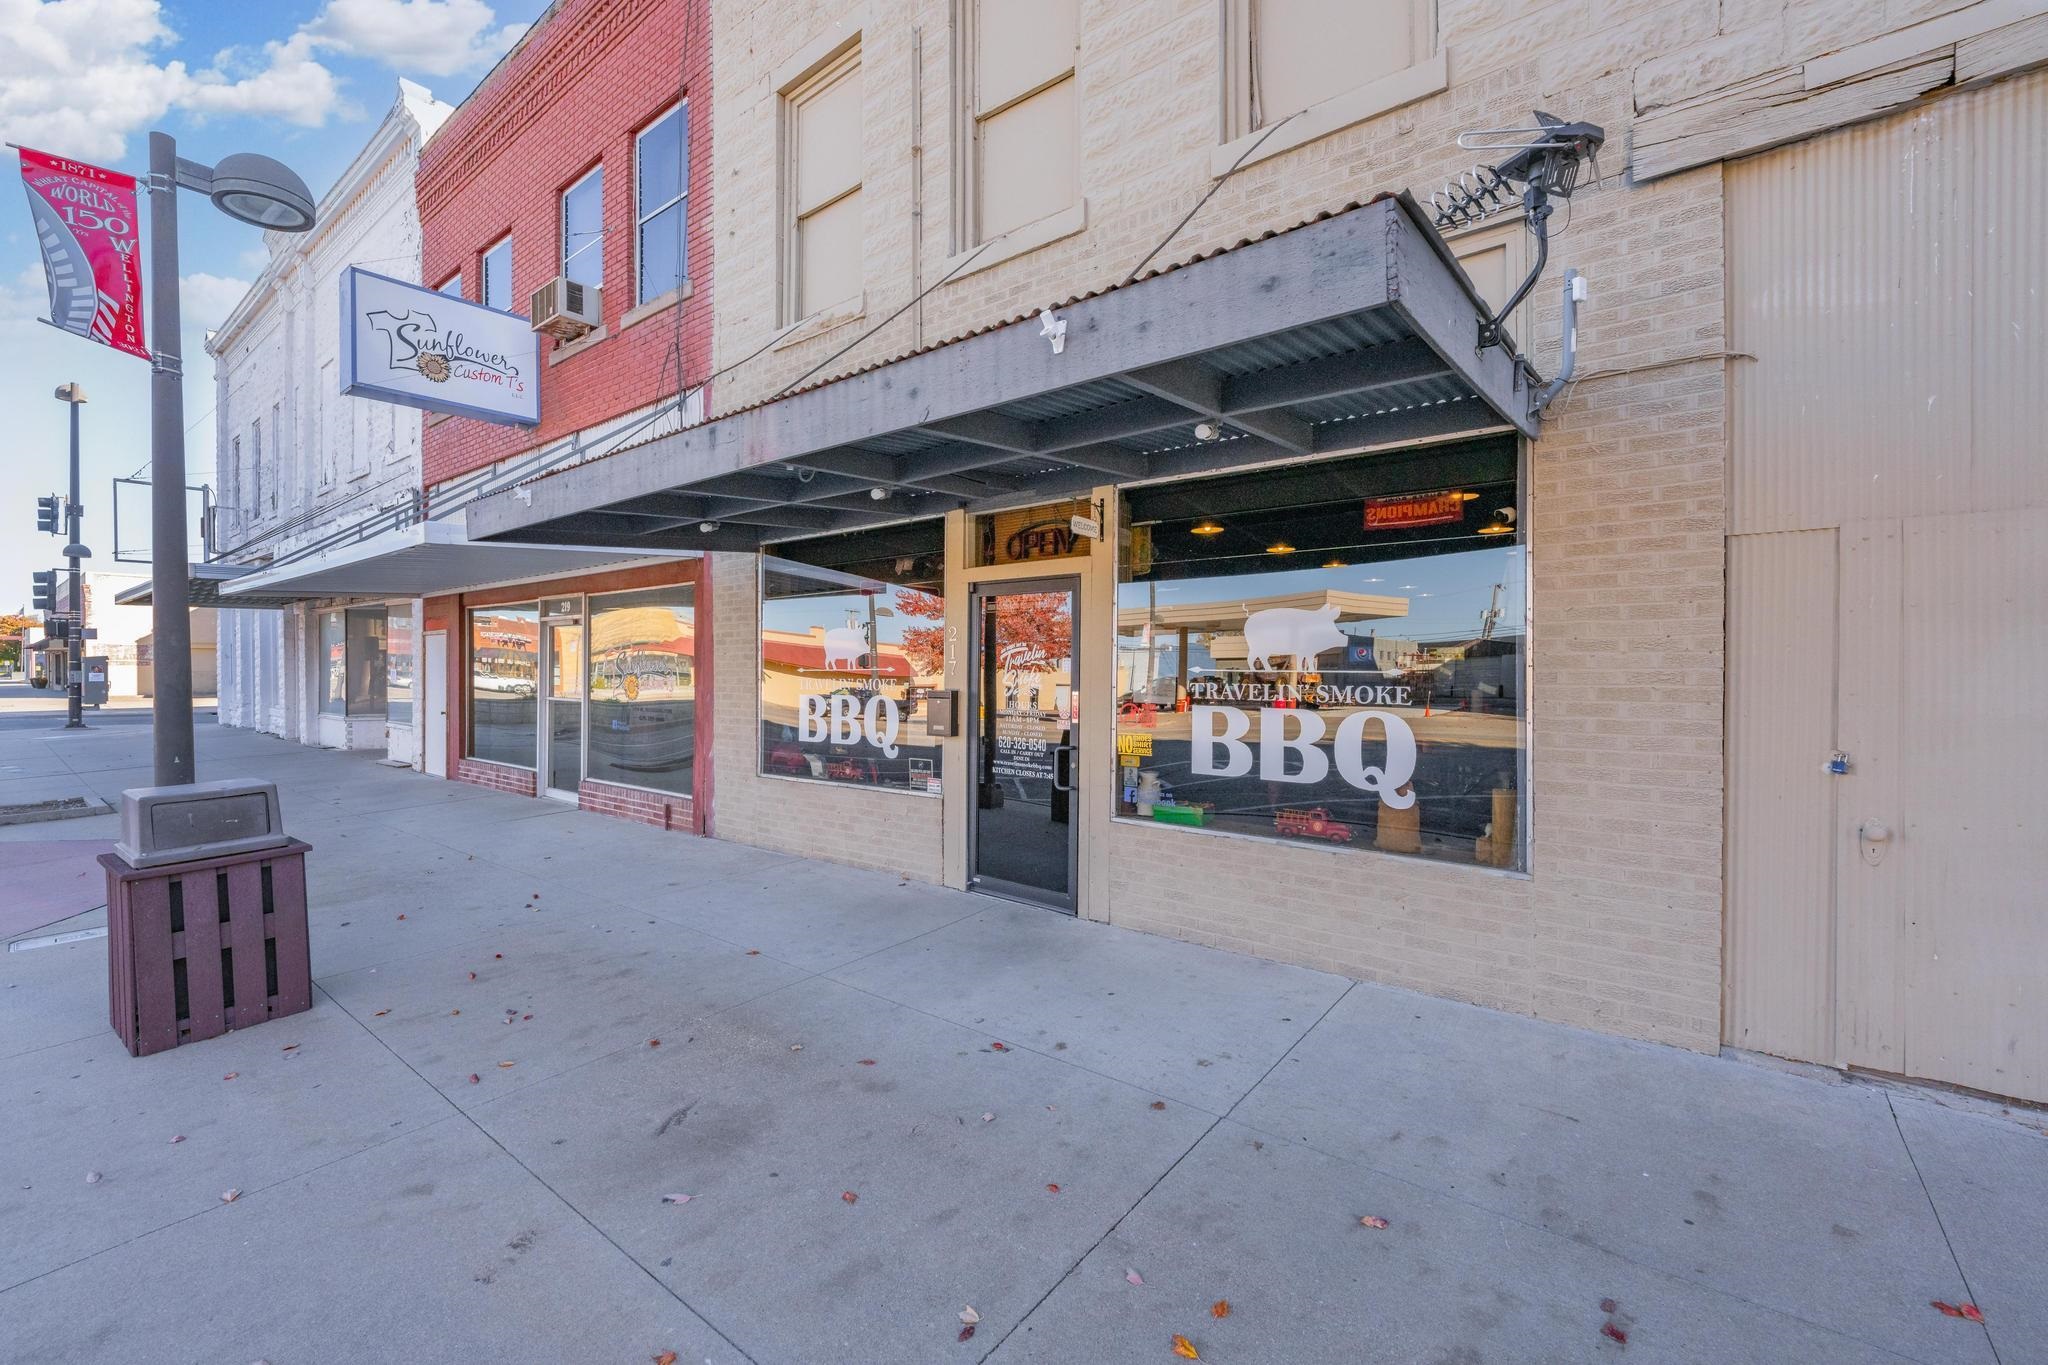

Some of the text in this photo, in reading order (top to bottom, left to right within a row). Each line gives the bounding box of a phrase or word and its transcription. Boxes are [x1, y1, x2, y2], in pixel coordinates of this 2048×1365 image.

[60, 160, 96, 179] 1871
[51, 183, 116, 213] WORLD
[71, 177, 119, 202] CAPITAL
[62, 206, 130, 235] 150
[109, 235, 137, 343] WELLINGTON
[396, 323, 519, 376] Sunflower
[453, 364, 525, 392] Custom T's
[1073, 519, 1098, 535] WELCOME
[1008, 528, 1071, 560] OPEN
[560, 600, 571, 613] 219
[948, 626, 957, 676] 217
[856, 678, 897, 691] SMOKE
[1190, 682, 1413, 706] TRAVELIN' SMOKE
[798, 694, 900, 759] BBQ
[998, 735, 1047, 751] 620-326-0540
[1117, 735, 1133, 753] NO
[1191, 704, 1418, 810] BBQ
[992, 766, 1015, 775] KITCHEN
[1015, 769, 1036, 778] CLOSES
